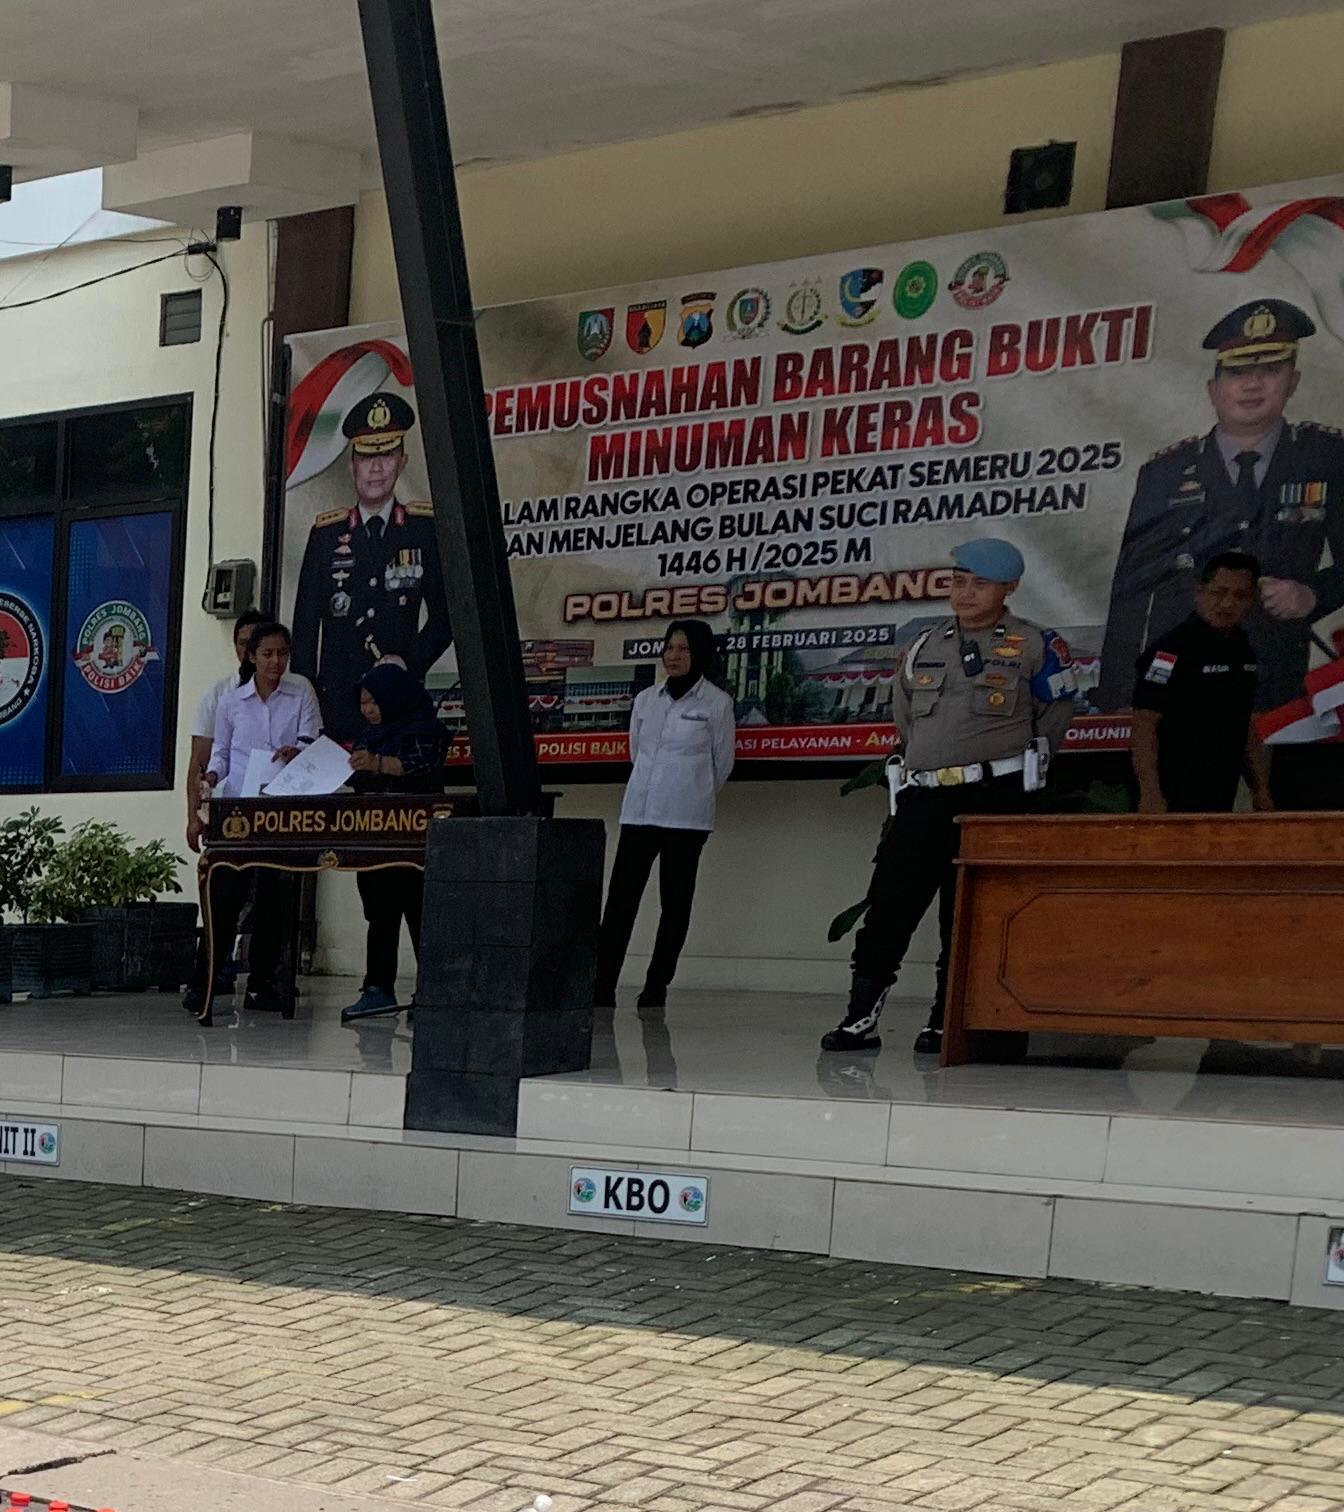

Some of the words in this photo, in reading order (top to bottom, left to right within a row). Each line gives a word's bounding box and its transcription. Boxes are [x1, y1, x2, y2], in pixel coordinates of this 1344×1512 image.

[773, 329, 974, 402] BARANG
[986, 305, 1153, 377] BUKTI
[588, 411, 810, 481] MINUMAN
[820, 392, 981, 458] KERAS
[503, 498, 559, 525] LAM
[565, 488, 681, 520] RANGKA
[686, 472, 807, 509] OPERASI
[812, 464, 903, 497] PEKAT
[908, 450, 1032, 487] SEMERU
[1036, 442, 1122, 475] 2025
[549, 517, 714, 553] MENJELANG
[719, 508, 813, 539] BULAN
[819, 500, 886, 531] SUCI
[892, 483, 1086, 523] RAMADHAN
[658, 548, 721, 576] 1446
[843, 537, 872, 563] M
[564, 584, 729, 622] POLRES
[733, 567, 953, 611] JOMBANG
[81, 608, 108, 645] POLRES
[111, 604, 147, 640] JOMBANG
[726, 636, 747, 650] 28
[752, 631, 836, 648] FEBRUARI
[842, 628, 890, 644] 2025
[83, 664, 114, 689] POLISI
[538, 742, 587, 755] POLISI
[591, 741, 627, 755] BAIK
[761, 736, 852, 749] PELAYANAN
[1065, 727, 1131, 741] OMUNI
[254, 810, 326, 833] POLRES
[330, 809, 429, 833] JOMBANG
[22, 1127, 37, 1157] II
[603, 1175, 670, 1214] KBO
